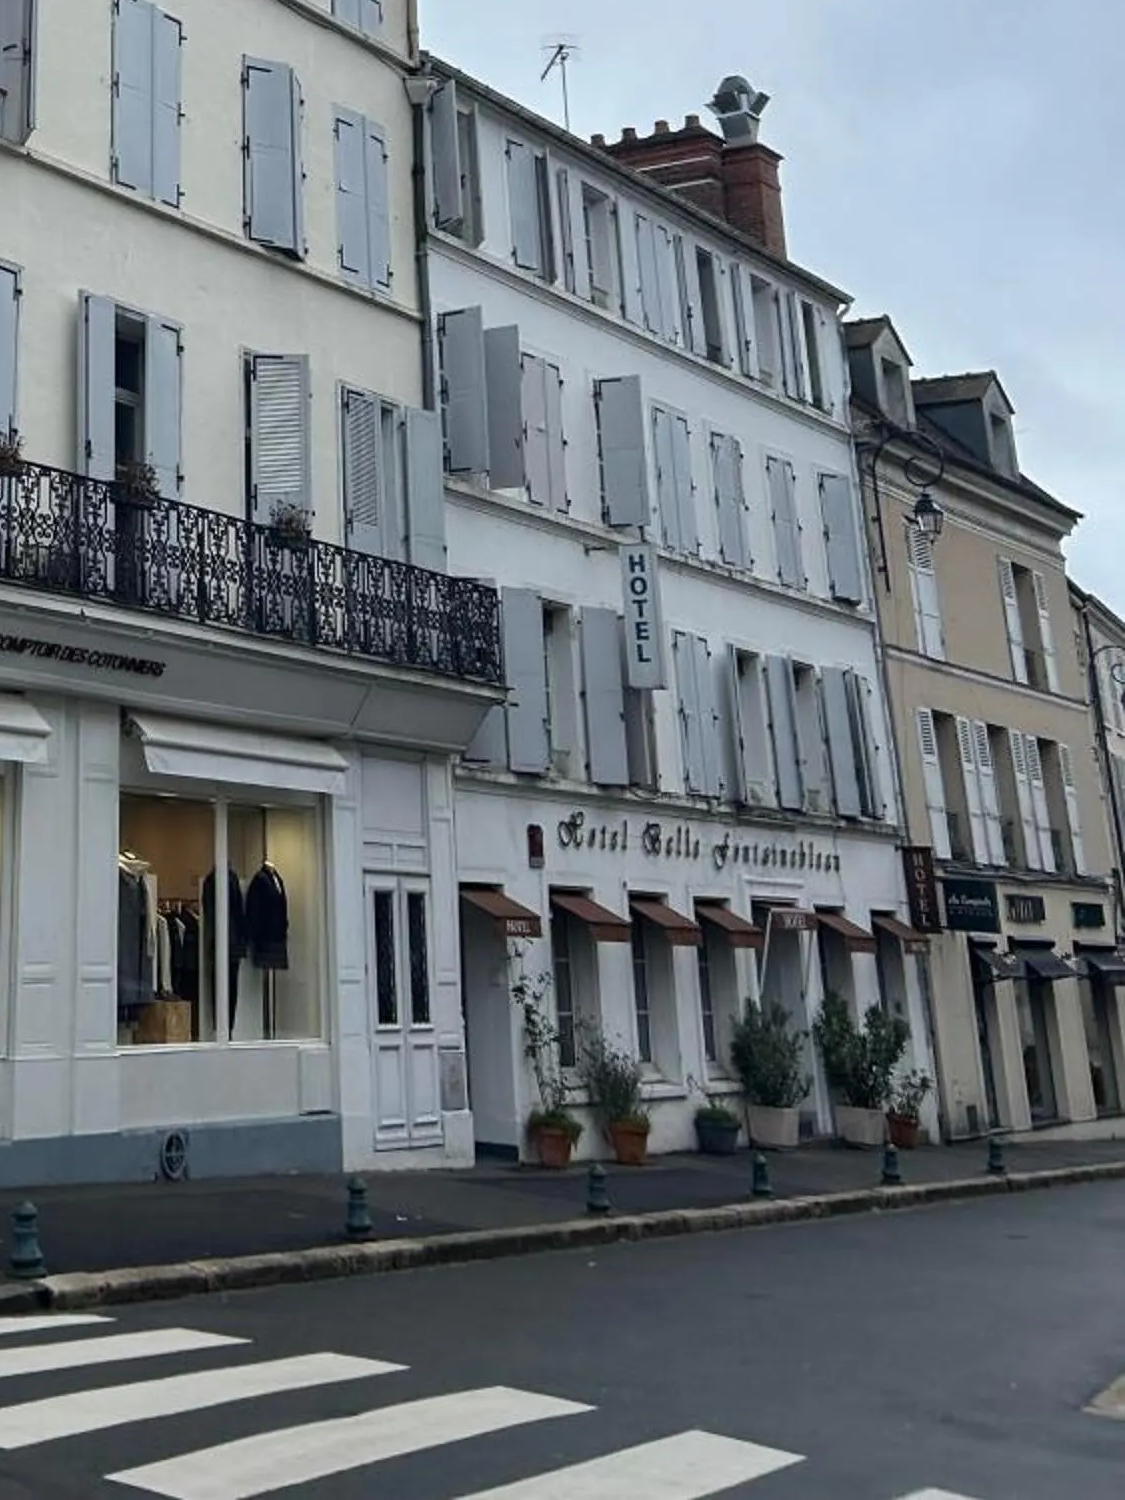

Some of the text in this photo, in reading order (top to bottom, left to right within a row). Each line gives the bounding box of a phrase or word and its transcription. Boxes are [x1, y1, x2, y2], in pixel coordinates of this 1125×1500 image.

[628, 553, 652, 662] HOTEL
[60, 647, 88, 663] DES
[913, 851, 931, 928] HOTEL
